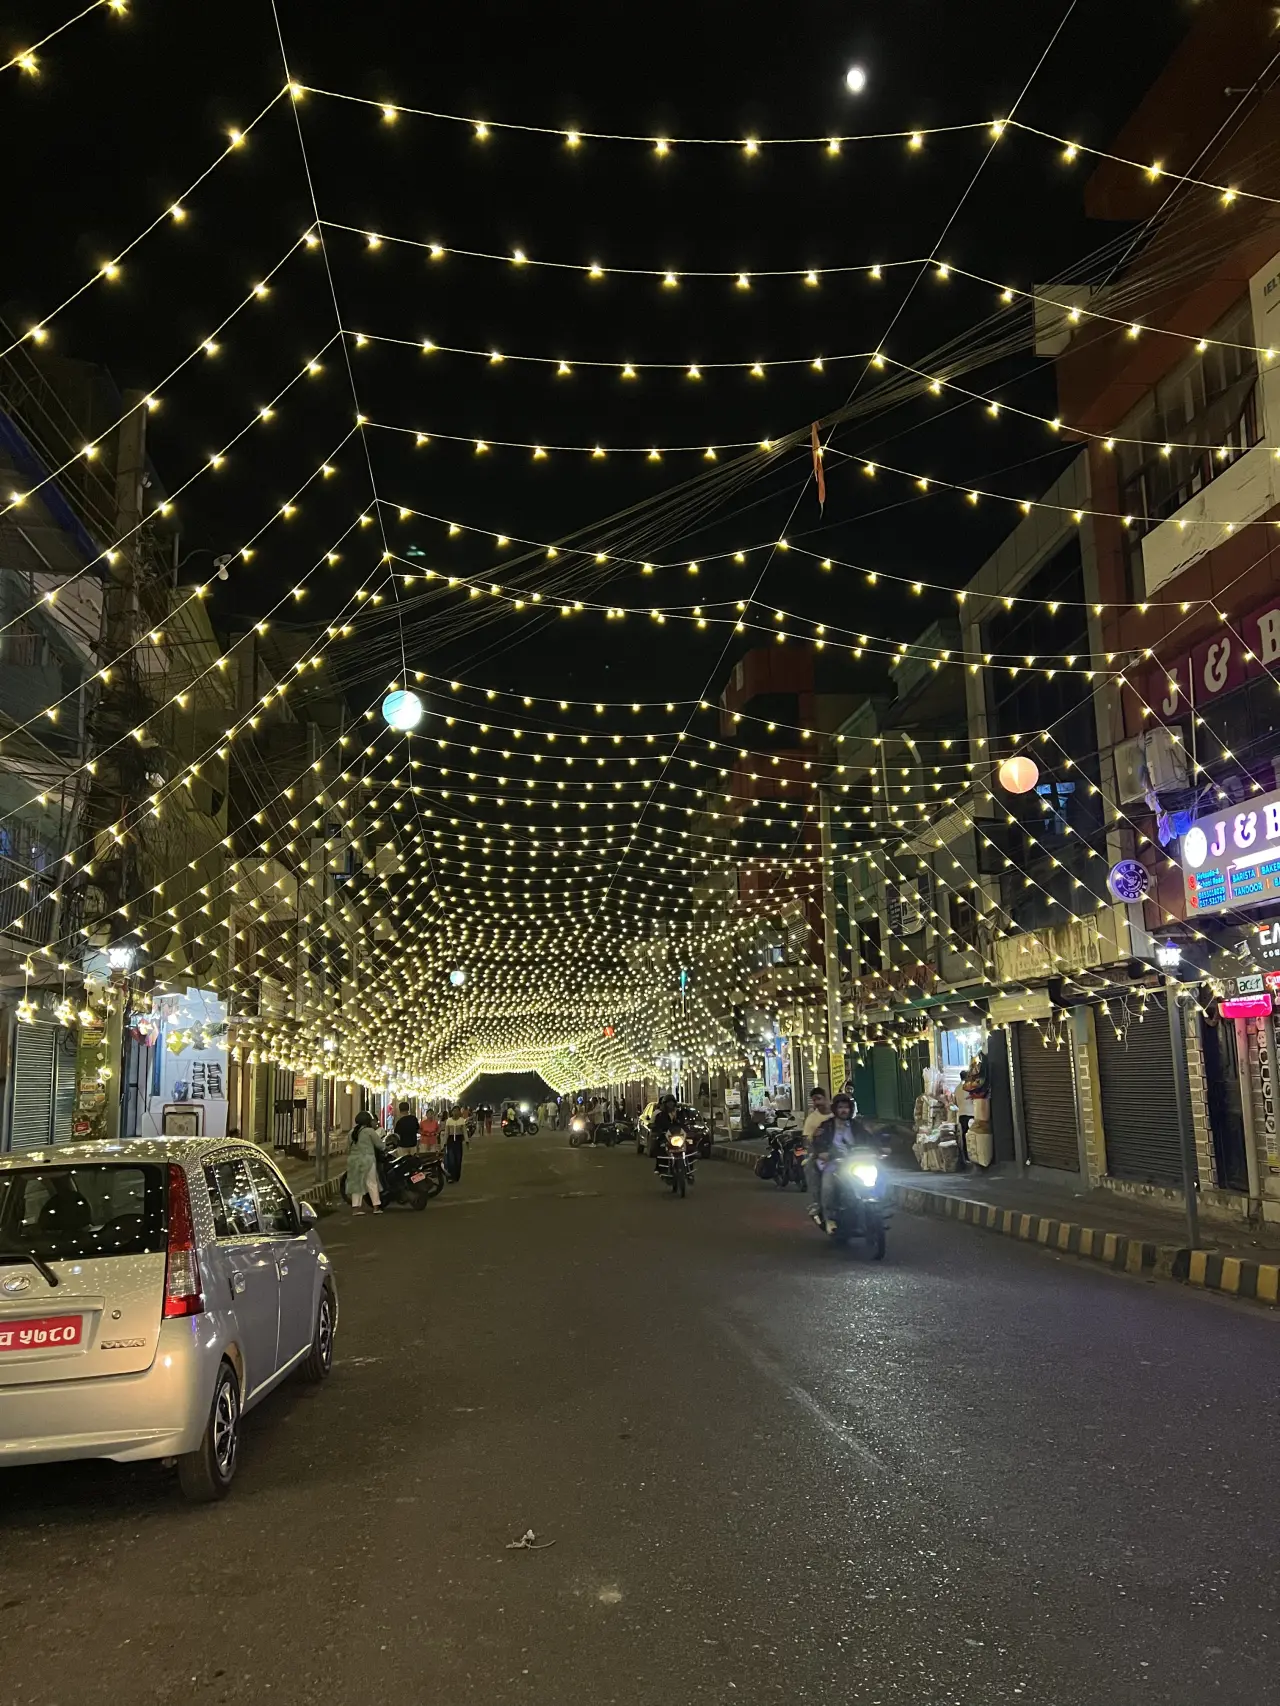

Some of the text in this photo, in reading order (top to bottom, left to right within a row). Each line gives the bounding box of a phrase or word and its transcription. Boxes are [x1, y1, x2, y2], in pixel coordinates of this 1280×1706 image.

[1162, 667, 1178, 716] J
[1203, 637, 1231, 693] &
[1211, 821, 1226, 857] J
[1233, 811, 1257, 848] &
[1232, 869, 1256, 883] BARISTA
[1233, 882, 1263, 897] TANDOOR
[19, 1326, 76, 1345] ५७८०
